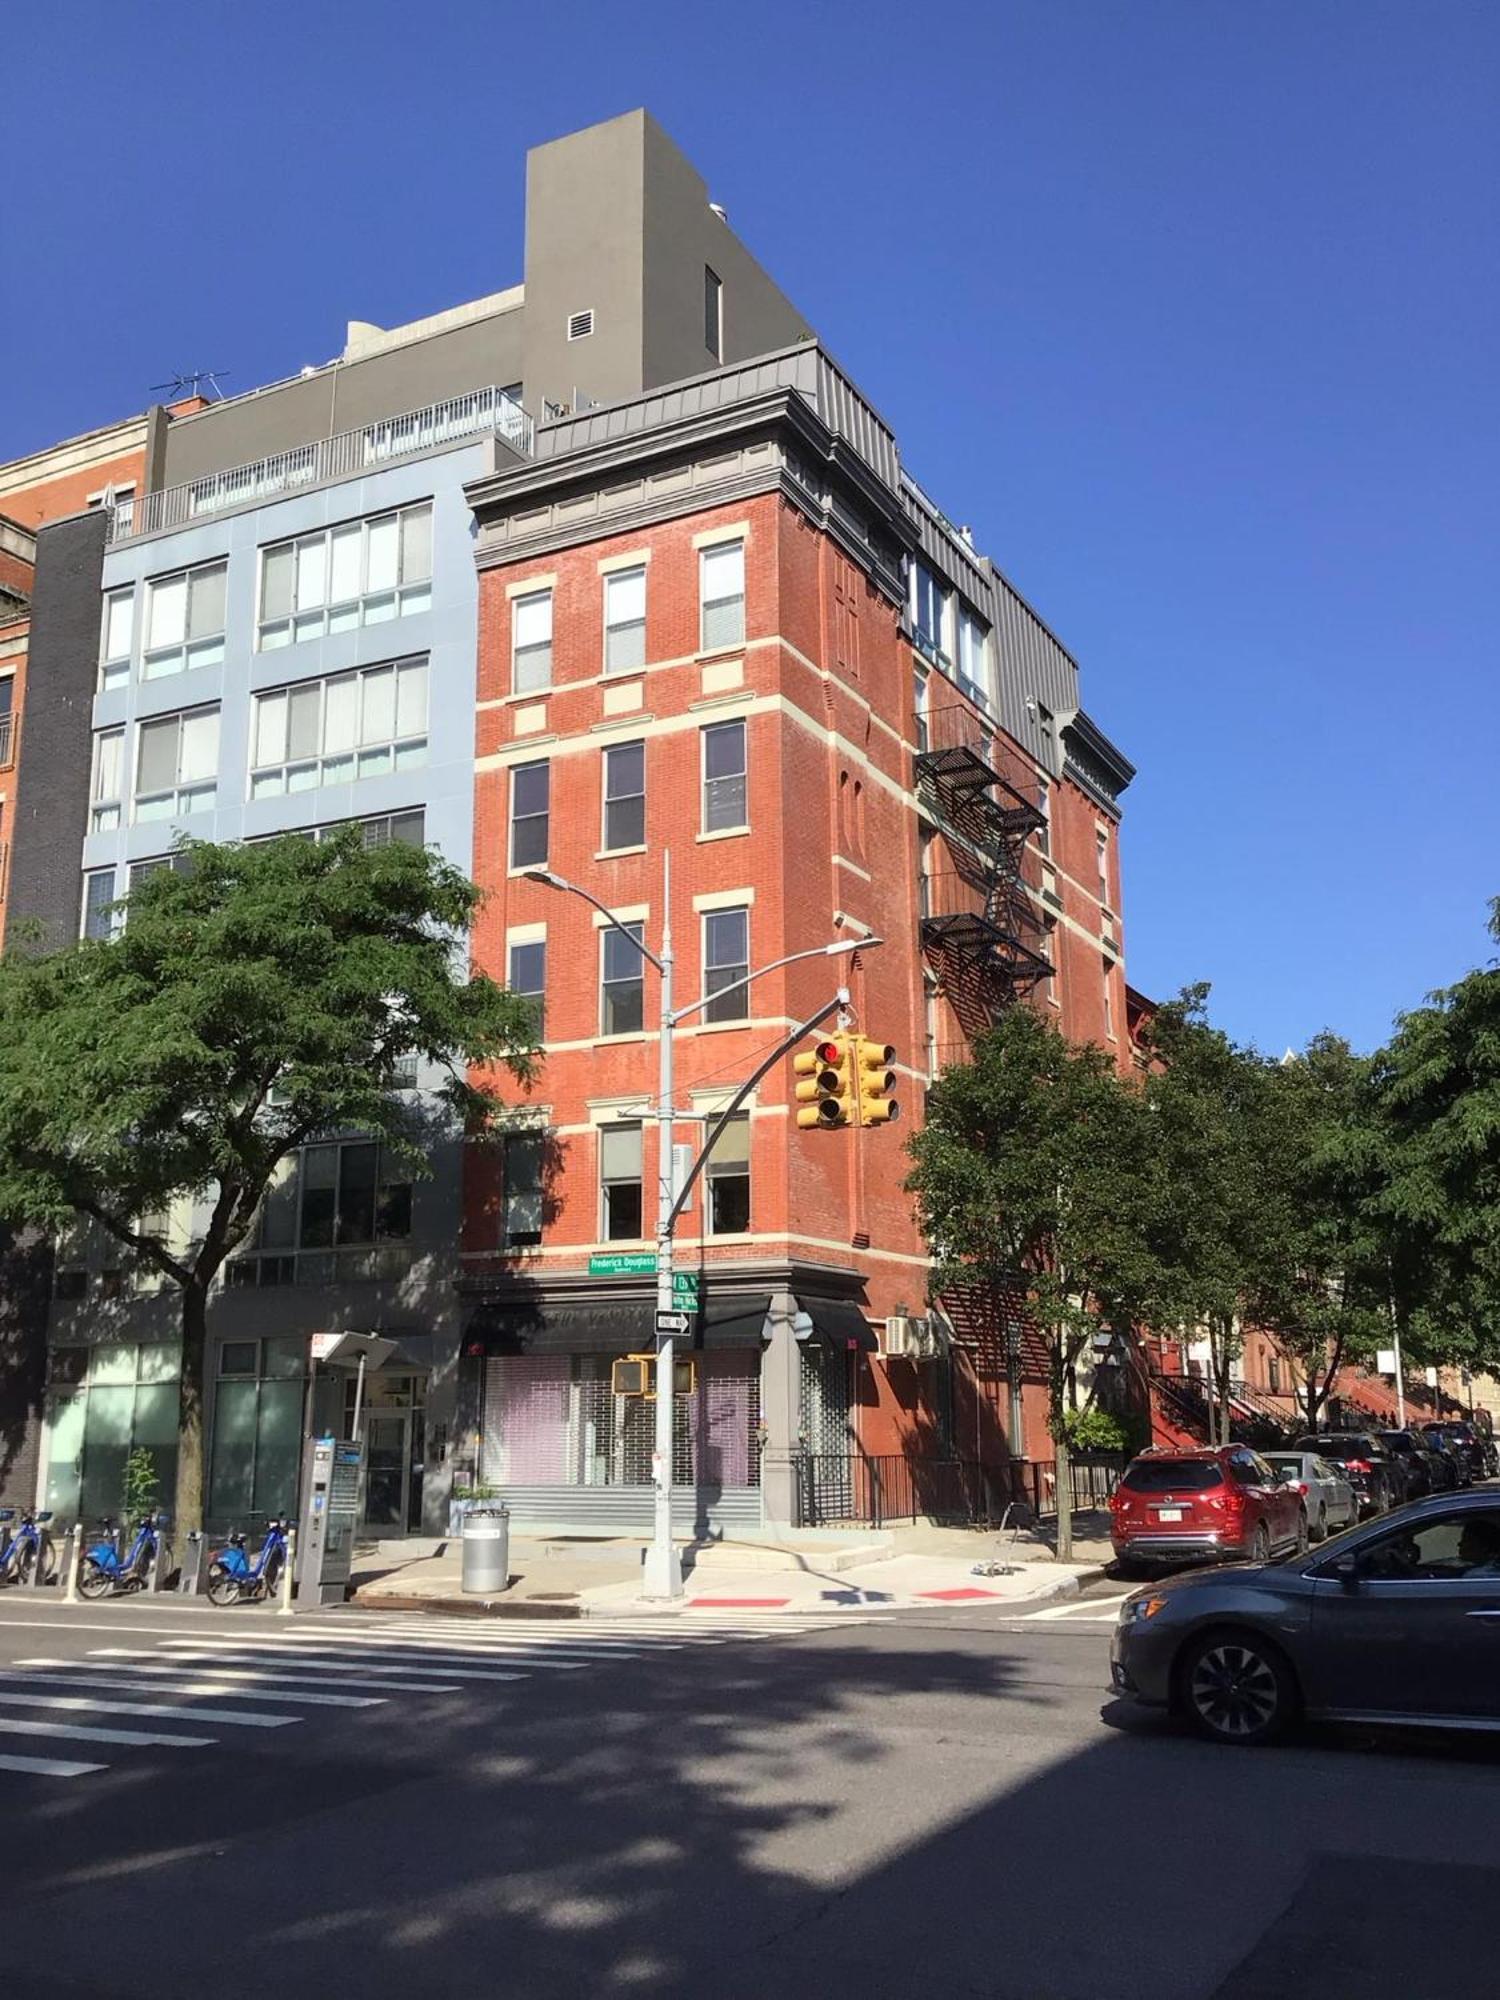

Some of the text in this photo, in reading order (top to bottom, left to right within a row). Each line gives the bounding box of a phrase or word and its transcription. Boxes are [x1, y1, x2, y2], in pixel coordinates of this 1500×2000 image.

[591, 1256, 655, 1268] Frederick Douglass
[660, 1318, 686, 1327] ONE WAY
